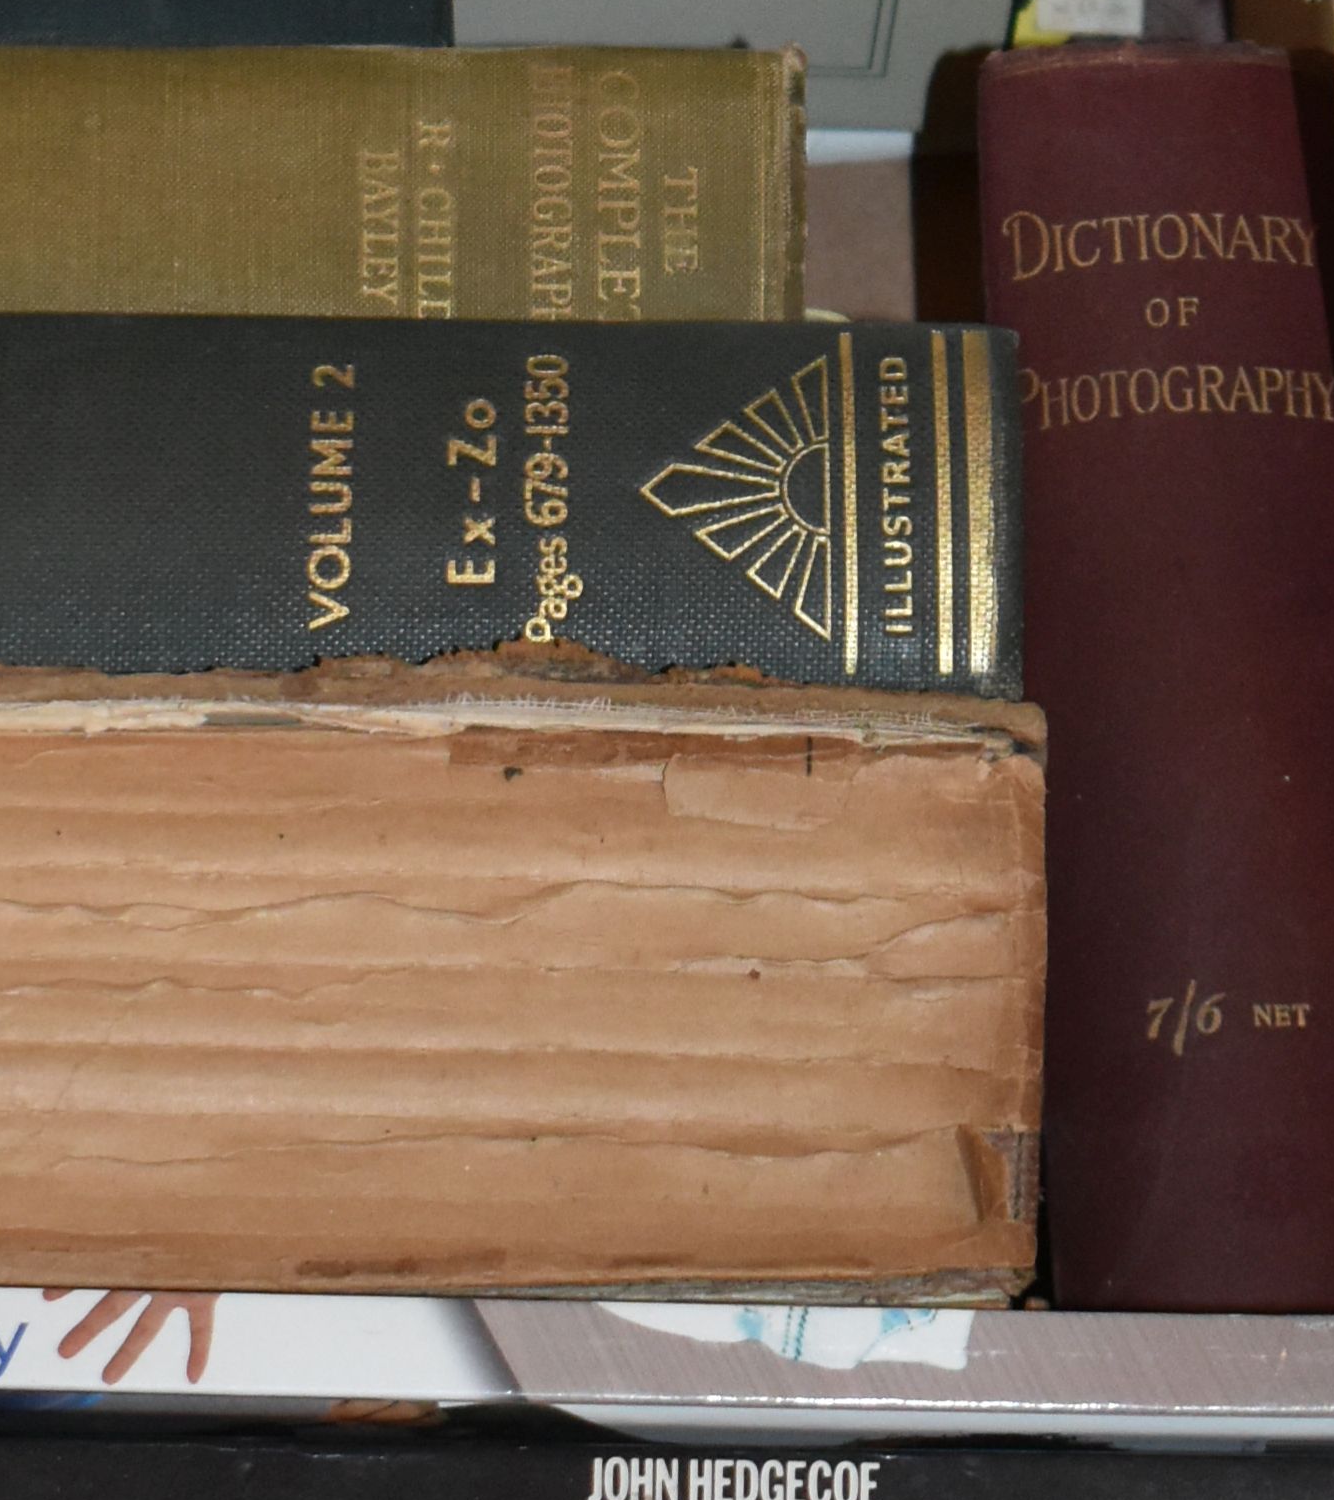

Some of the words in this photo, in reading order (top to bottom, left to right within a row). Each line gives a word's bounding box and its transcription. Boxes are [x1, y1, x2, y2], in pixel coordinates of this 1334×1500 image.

[358, 148, 401, 307] BAYLEY
[665, 165, 701, 277] THE
[1002, 207, 1324, 286] DICTIONARY
[1144, 294, 1200, 329] OF
[311, 360, 356, 390] 2
[524, 353, 570, 528] 679-1350
[878, 354, 915, 636] ILLUSTRATED
[307, 405, 355, 633] VOLUME
[524, 532, 585, 645] Pages
[1144, 976, 1224, 1058] 7/6
[1253, 1001, 1311, 1030] NET
